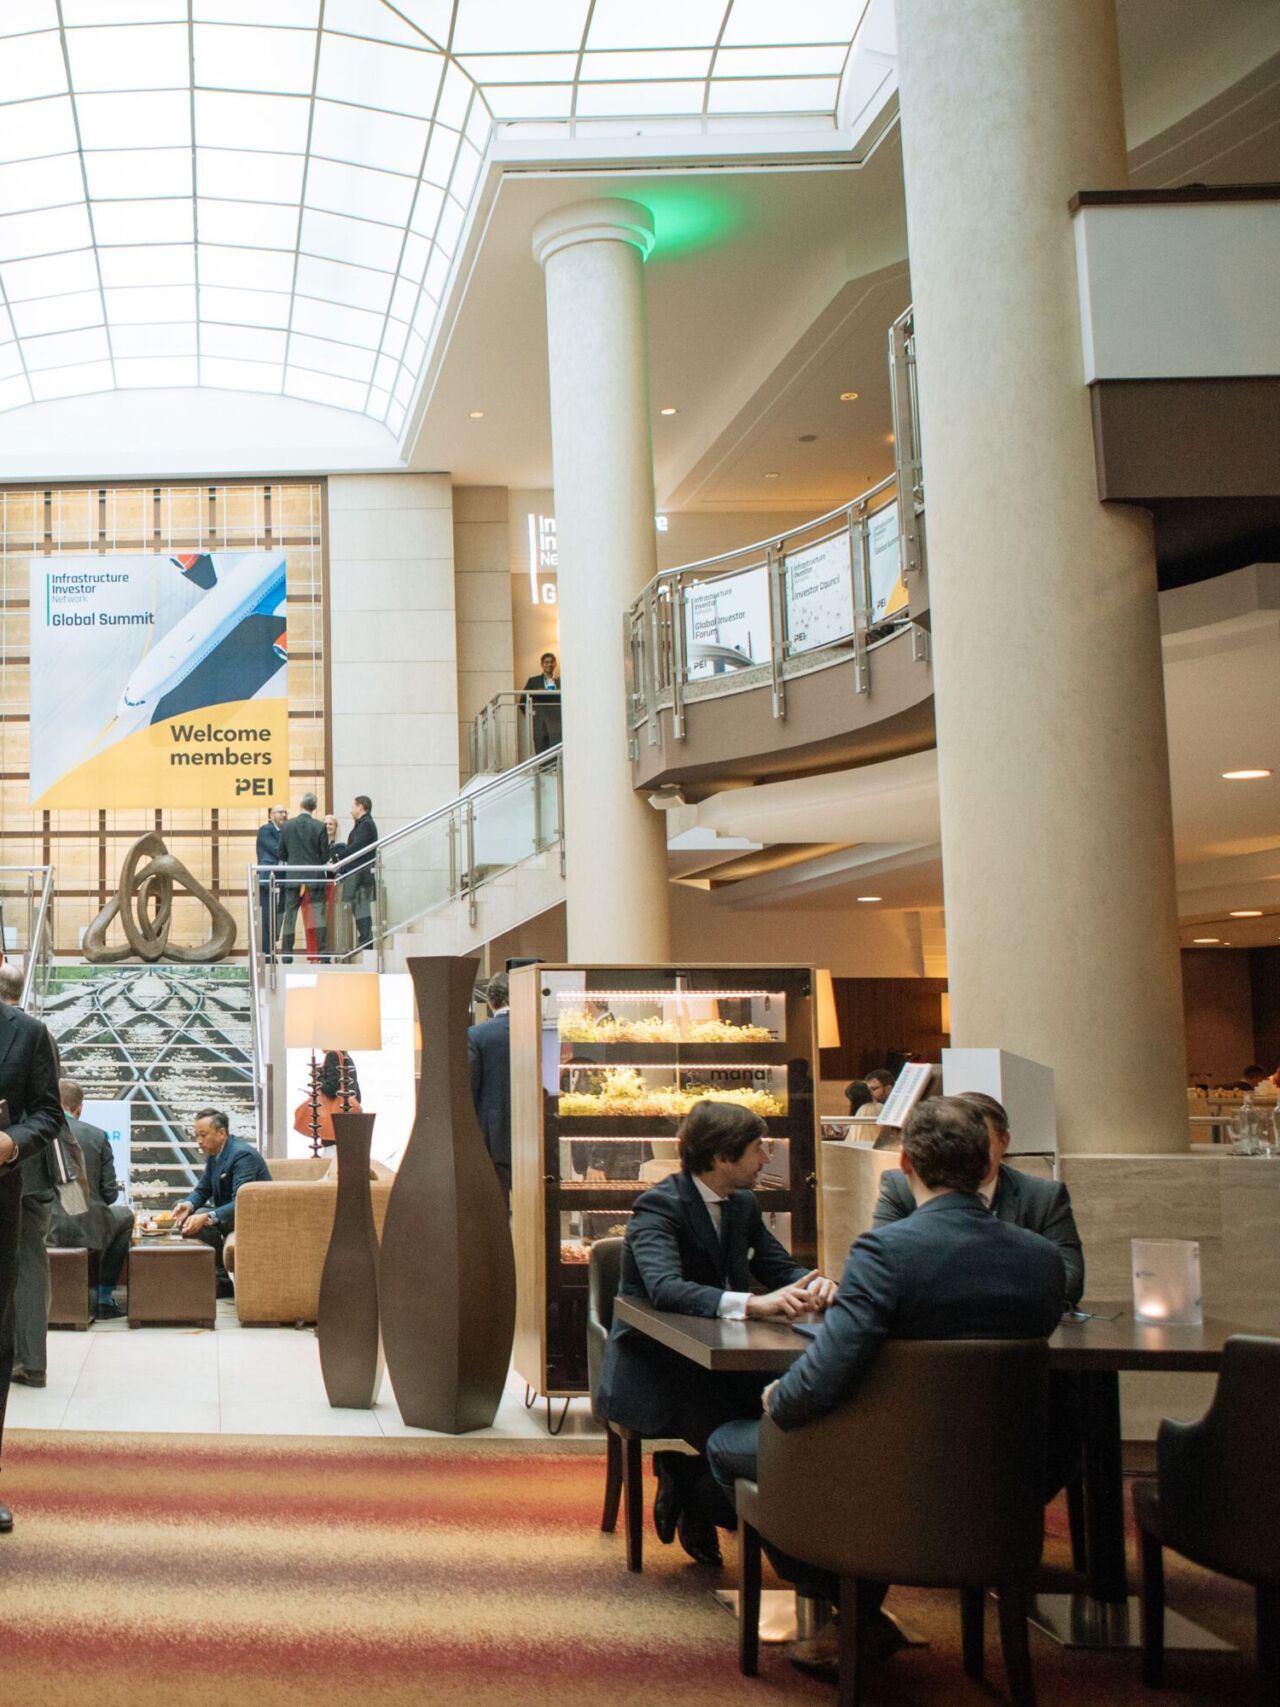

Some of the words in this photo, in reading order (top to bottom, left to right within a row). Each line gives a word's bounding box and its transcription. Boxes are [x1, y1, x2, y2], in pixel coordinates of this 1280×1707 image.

[52, 573, 129, 584] Infrastructure
[52, 584, 96, 594] Investor
[52, 595, 88, 603] Network
[52, 612, 95, 626] Global
[99, 611, 155, 625] Summit
[695, 617, 717, 631] Global
[695, 628, 718, 640] Forum
[170, 723, 272, 742] Welcome
[170, 747, 272, 766] members
[235, 778, 273, 796] PEI
[710, 1070, 766, 1081] mana
